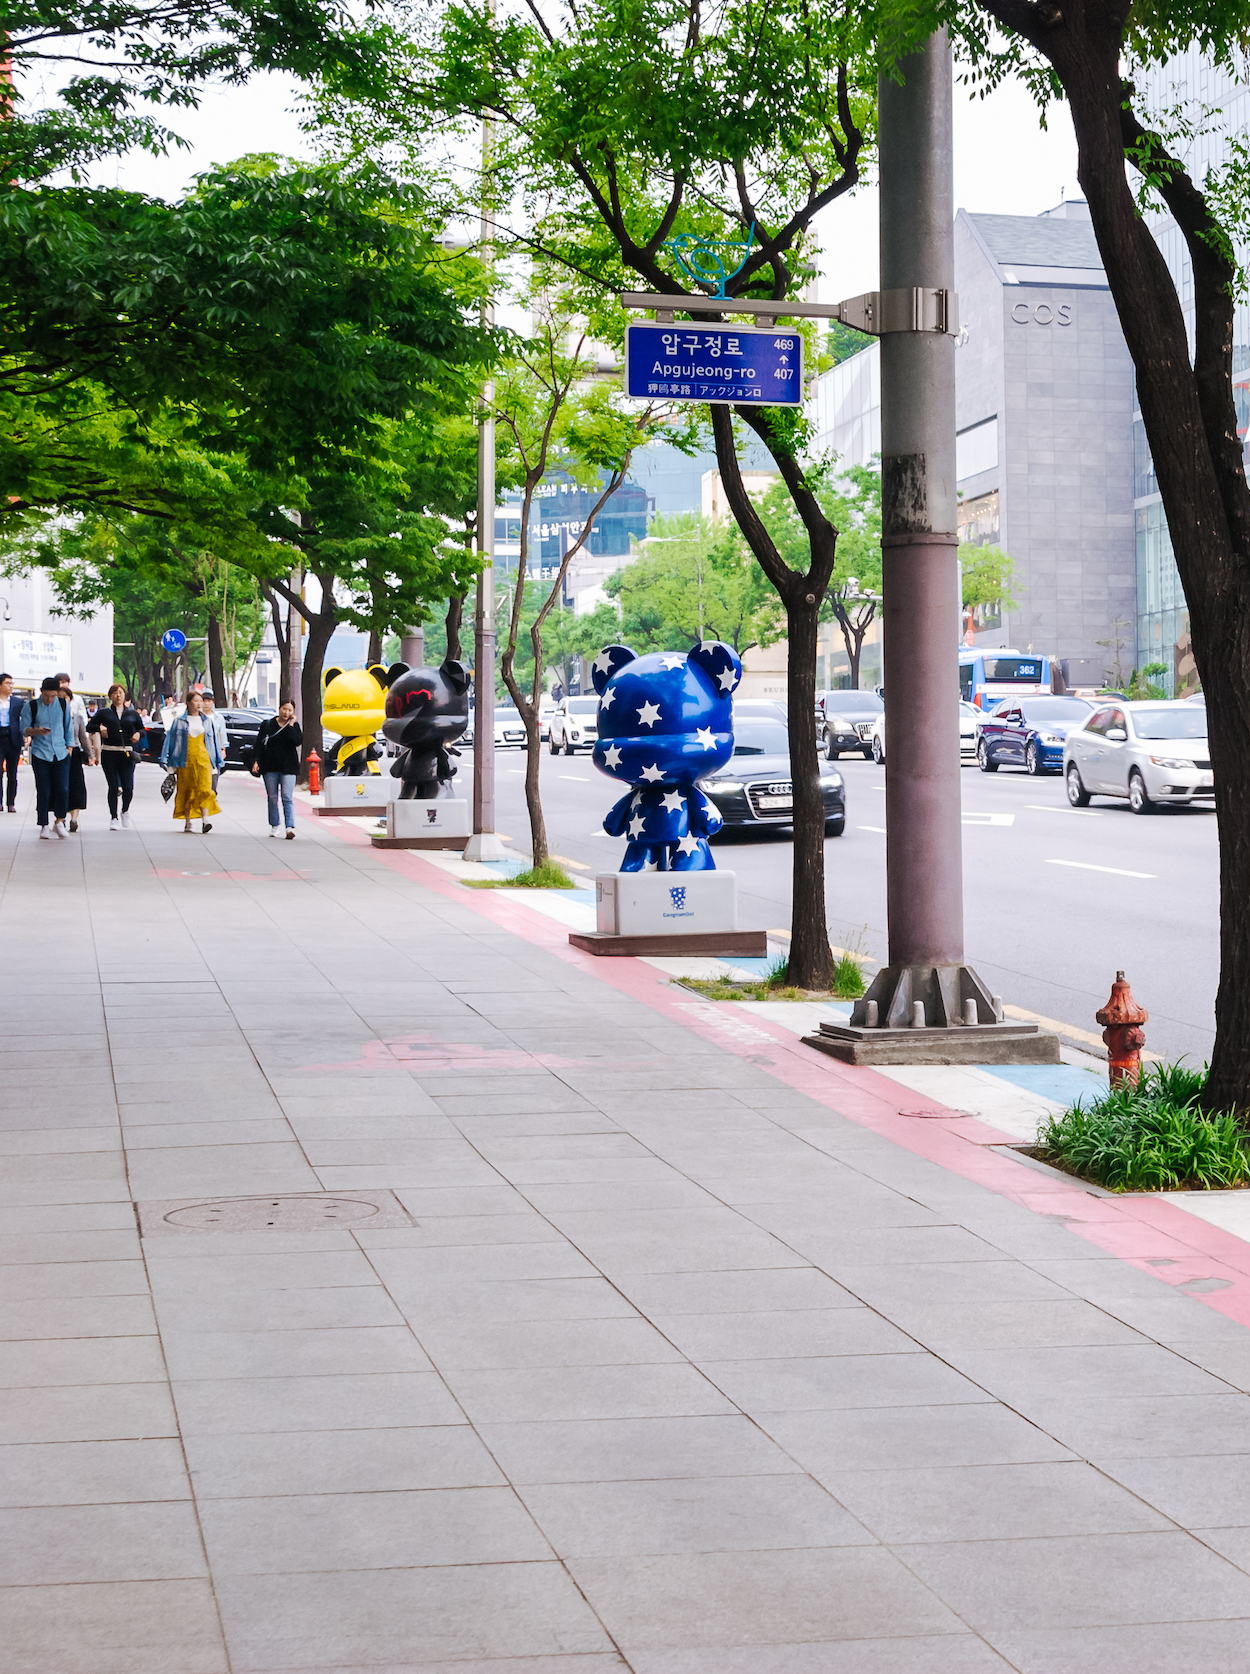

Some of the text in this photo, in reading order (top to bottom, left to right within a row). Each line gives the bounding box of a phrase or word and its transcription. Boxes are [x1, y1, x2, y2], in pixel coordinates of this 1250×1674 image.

[1011, 303, 1072, 327] COS
[661, 333, 744, 358] 압구정로
[773, 339, 794, 351] 469
[651, 360, 757, 381] Apgujeong-ro
[773, 368, 794, 381] 407
[1019, 665, 1035, 675] 362
